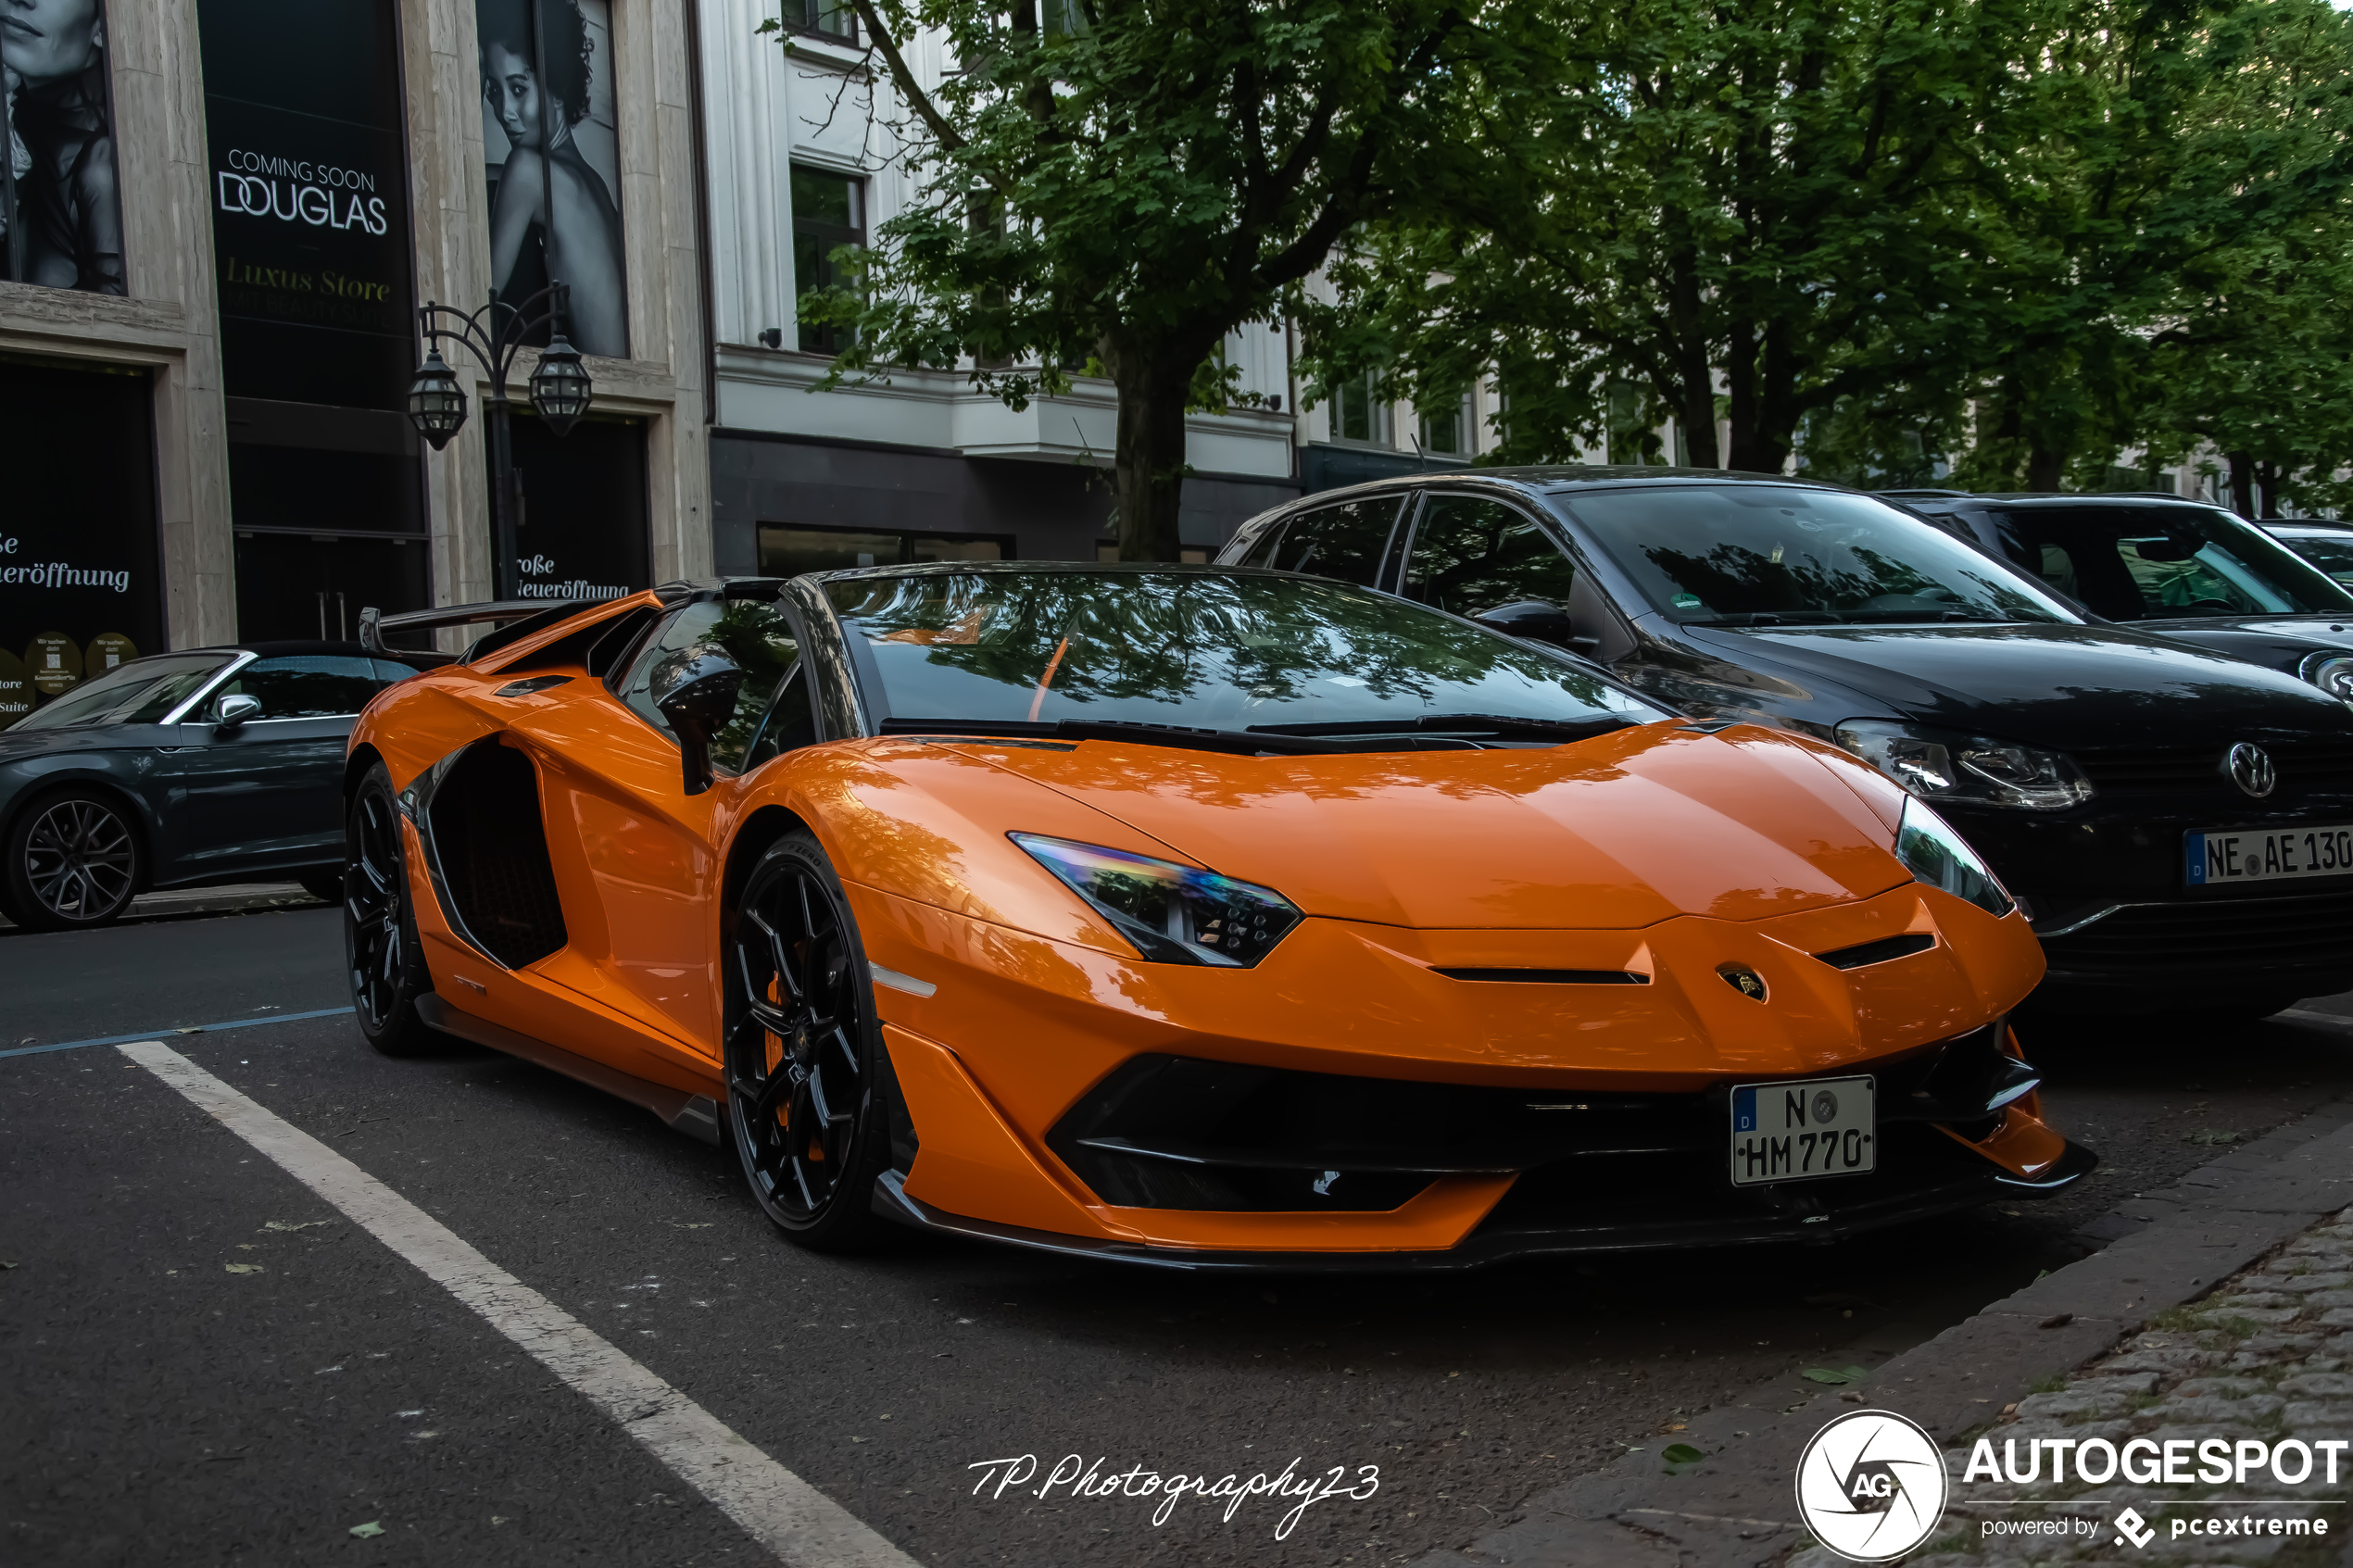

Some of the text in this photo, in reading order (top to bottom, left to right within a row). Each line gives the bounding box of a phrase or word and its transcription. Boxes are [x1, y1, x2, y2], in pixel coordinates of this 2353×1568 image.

[229, 149, 374, 192] COMING SOON
[219, 171, 387, 235] DOUGLAS
[227, 257, 390, 303] Luxus Store
[228, 289, 391, 329] MIT BEAUTY SUITE
[795, 845, 822, 867] ZERO
[2194, 865, 2201, 876] D
[2208, 831, 2353, 877] NE AE 130
[1741, 1115, 1750, 1129] D
[1784, 1088, 1805, 1128] N
